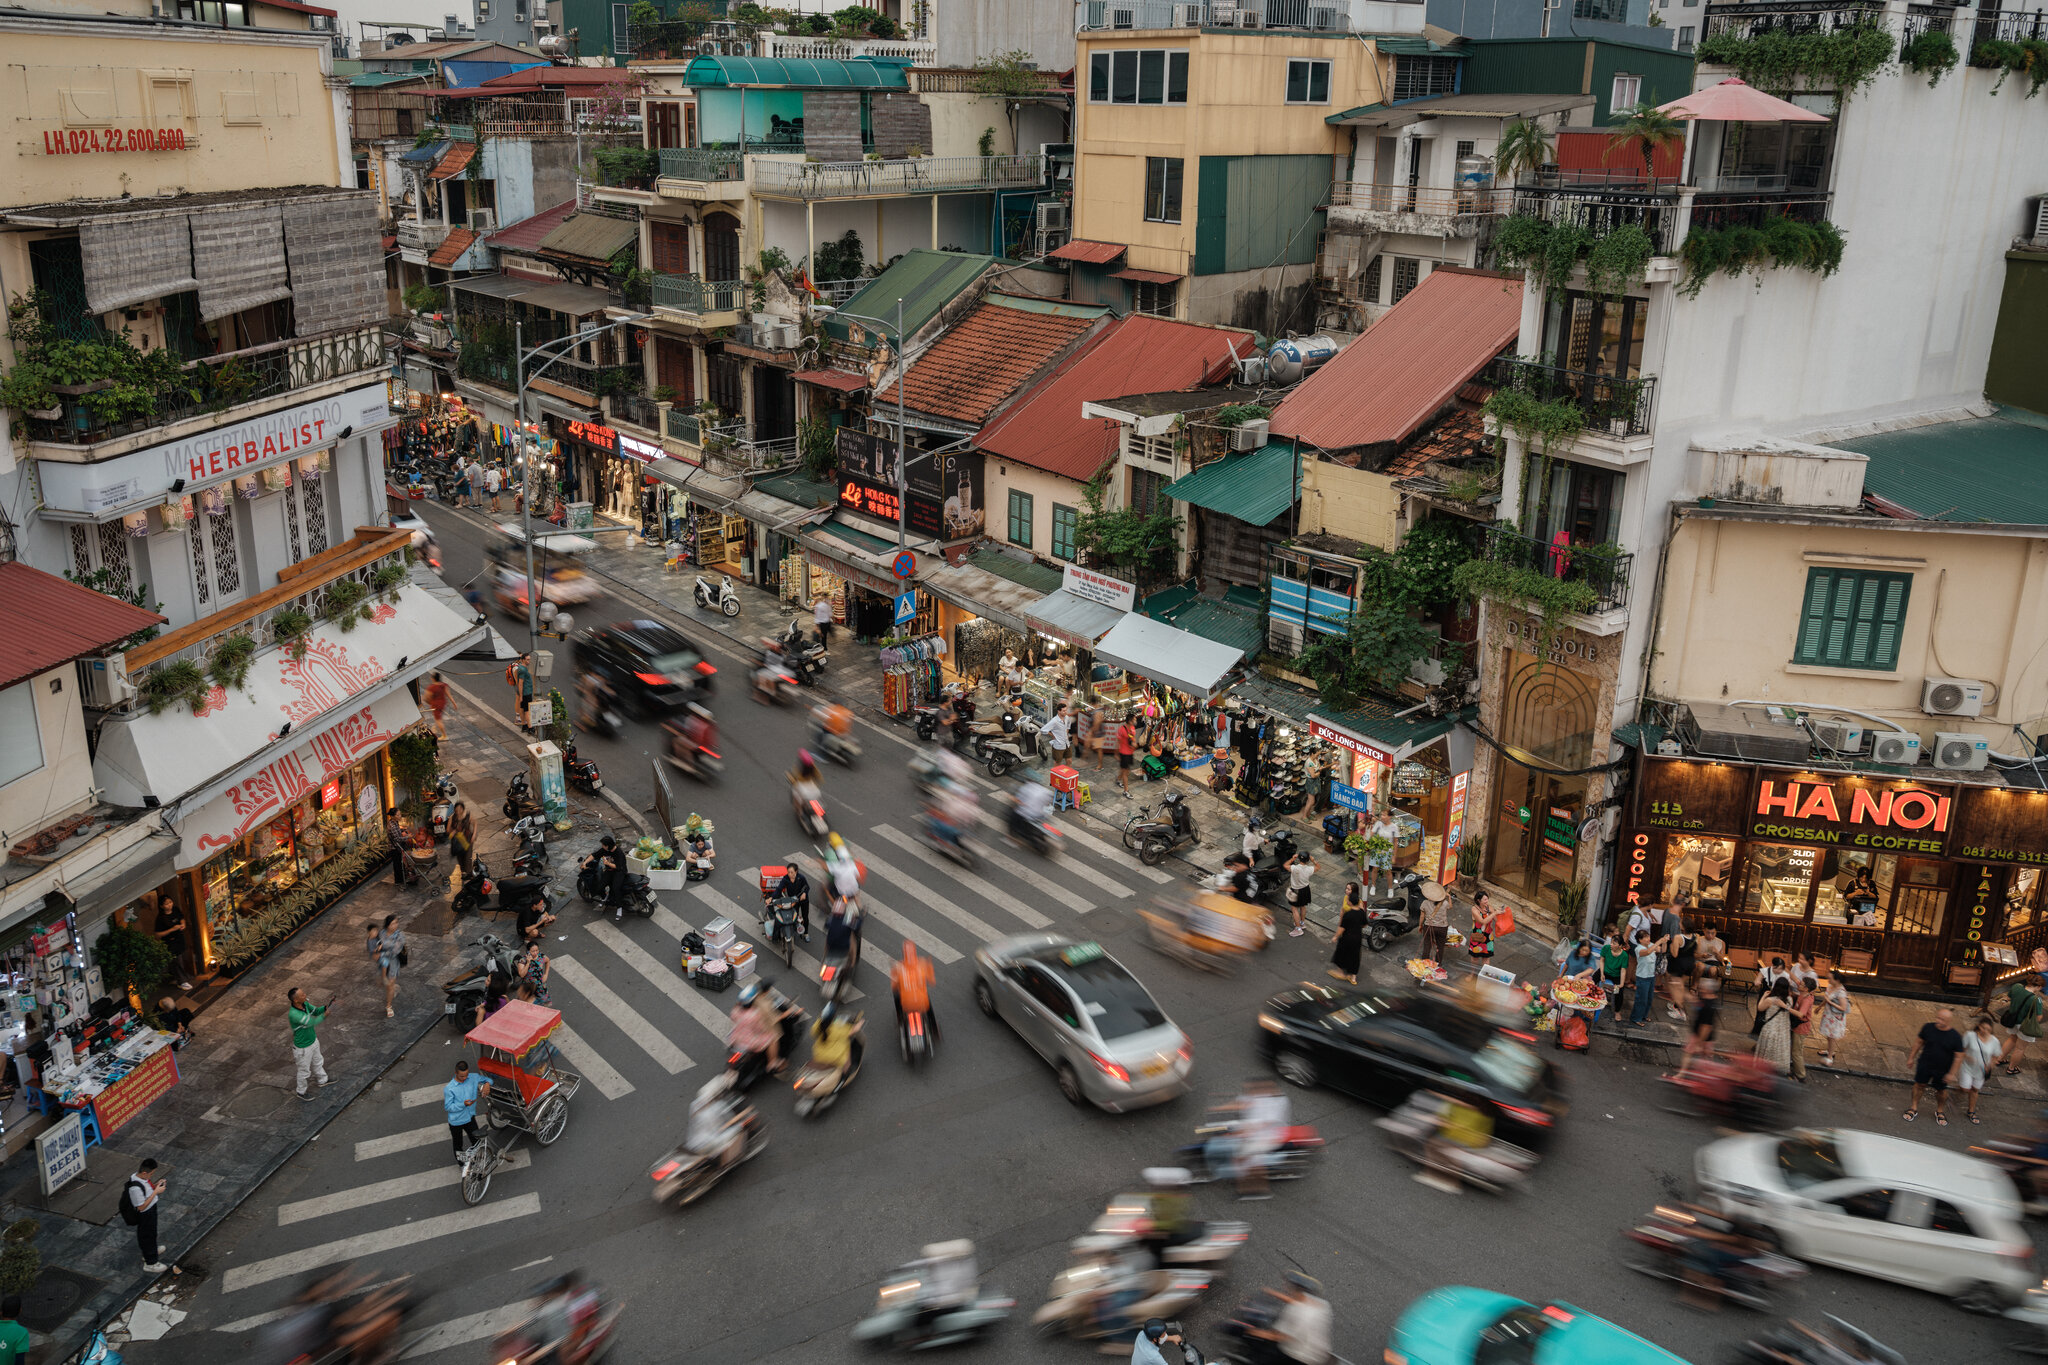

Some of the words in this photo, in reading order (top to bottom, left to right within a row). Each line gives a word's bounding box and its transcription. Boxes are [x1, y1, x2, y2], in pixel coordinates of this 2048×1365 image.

[44, 128, 185, 155] LH.024.22.600.600
[189, 419, 325, 481] HERBALIST
[841, 482, 863, 508] Lệ
[864, 487, 885, 504] HONG
[1507, 619, 1597, 662] DELSOIE
[1531, 645, 1566, 665] HTEL
[1318, 726, 1334, 741] ĐỨC
[1335, 734, 1355, 749] LONG
[1356, 741, 1384, 762] WATCH
[1651, 801, 1683, 815] 113
[1547, 816, 1575, 836] TRAVEL
[1544, 828, 1576, 848] AGENCY
[1871, 835, 1943, 853] COFFEE
[1962, 846, 1986, 857] 081
[1989, 849, 2014, 860] 246
[2018, 851, 2048, 863] 3113
[99, 1093, 121, 1112] PHONE
[106, 1098, 127, 1116] PHONE
[49, 1148, 81, 1177] BEER
